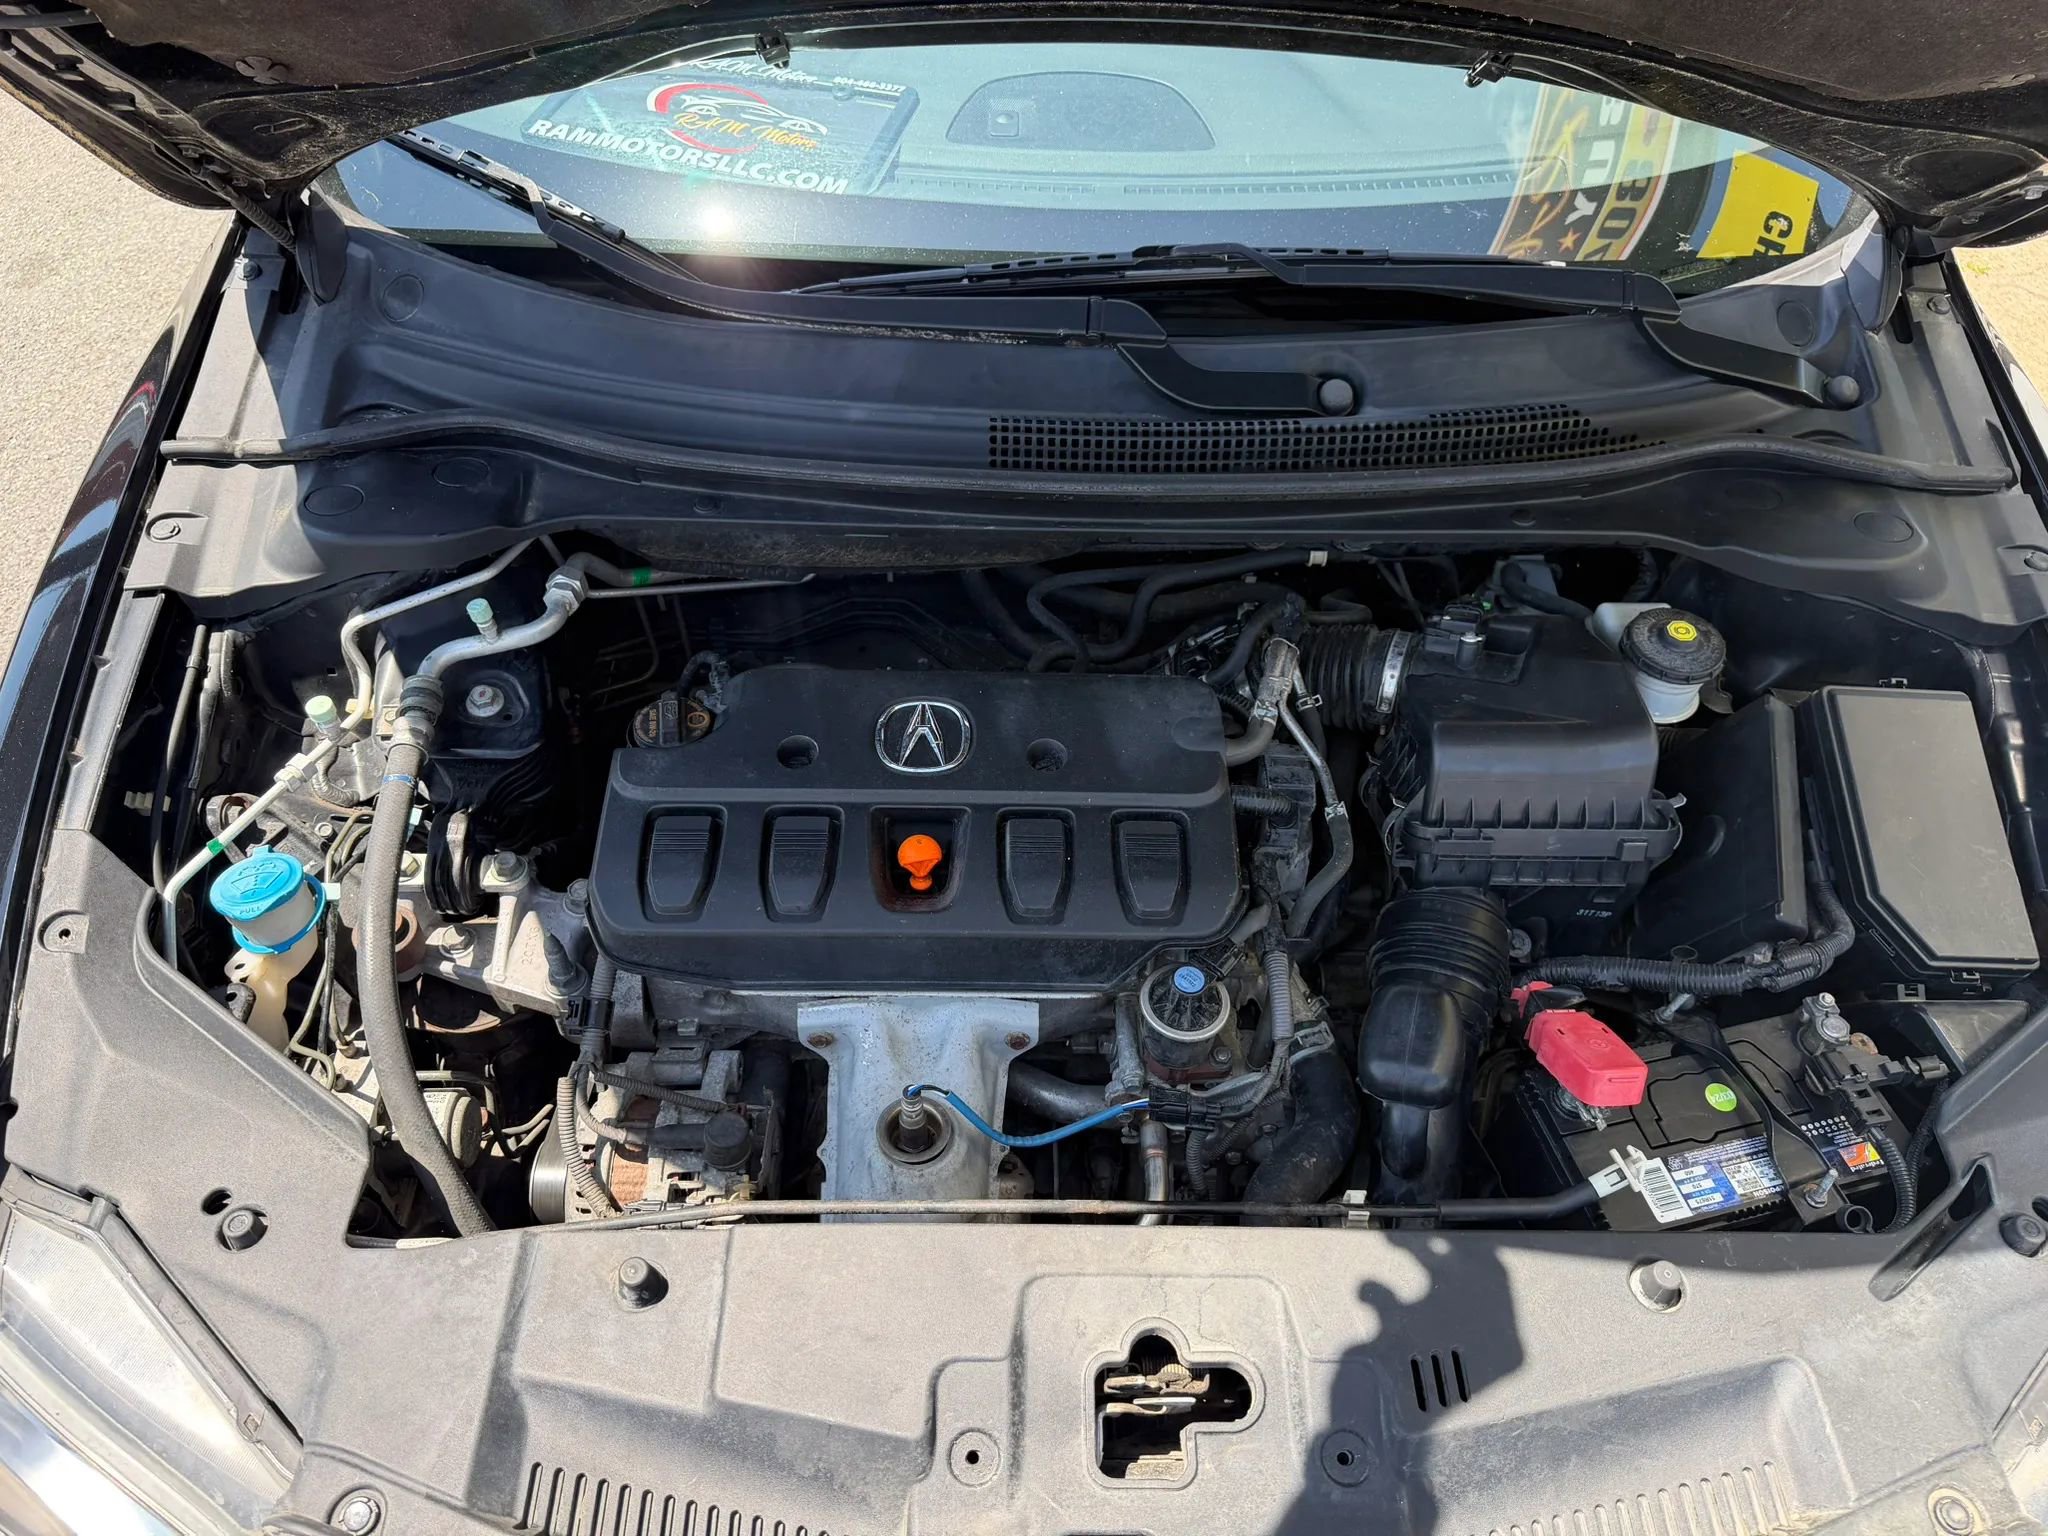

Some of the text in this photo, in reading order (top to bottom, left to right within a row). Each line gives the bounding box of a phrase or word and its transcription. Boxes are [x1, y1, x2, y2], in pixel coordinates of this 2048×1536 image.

[528, 119, 848, 195] RAMMOTORSLLC.COM
[674, 113, 817, 149] RAM Motors
